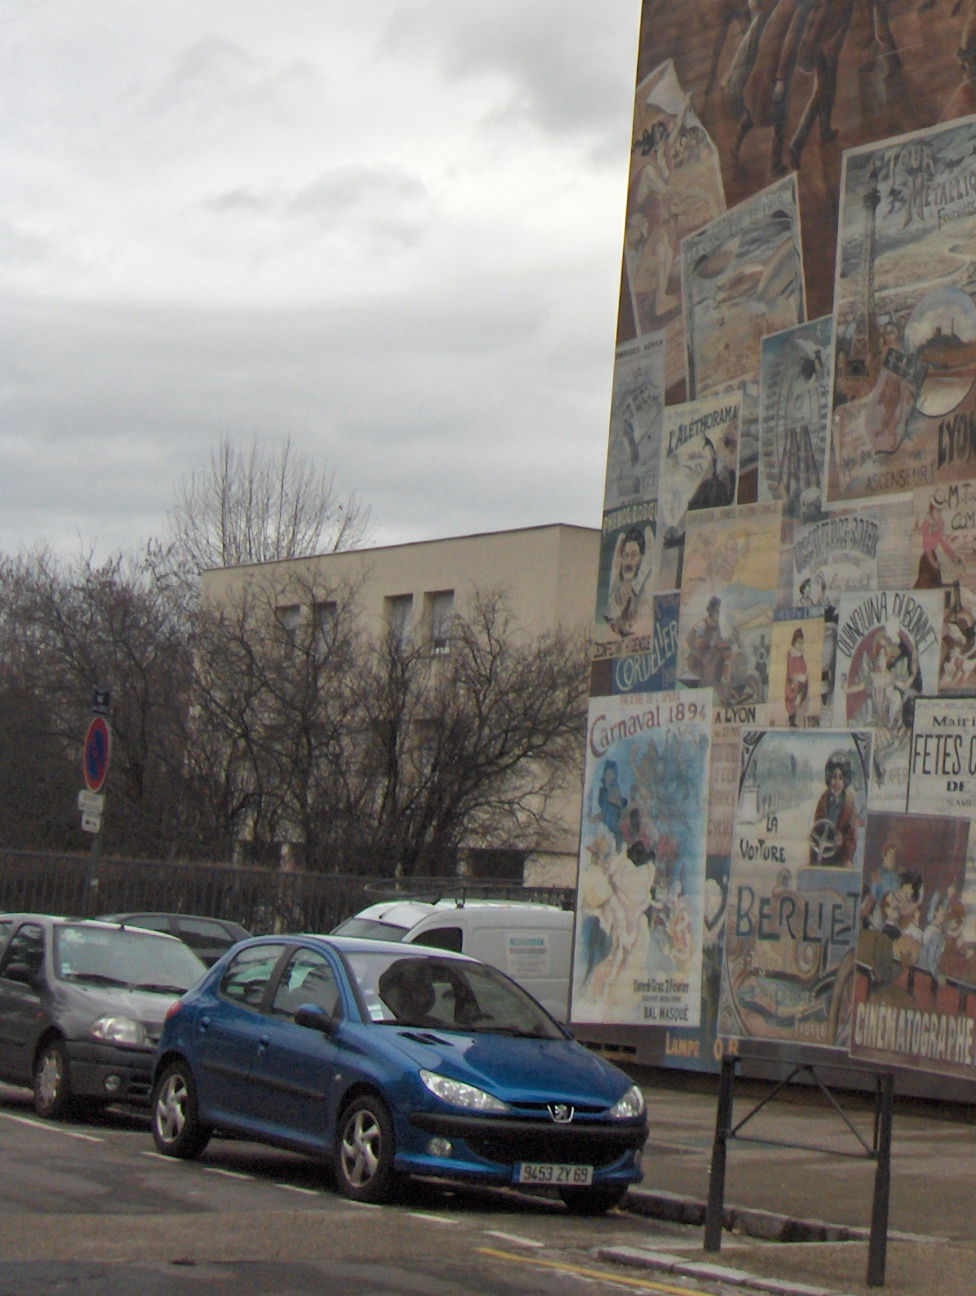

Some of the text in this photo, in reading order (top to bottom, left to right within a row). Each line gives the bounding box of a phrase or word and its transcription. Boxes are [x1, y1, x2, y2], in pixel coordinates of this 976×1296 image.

[837, 592, 888, 658] QUINQUINA
[715, 707, 756, 723] A LYON
[589, 702, 706, 758] Carnaval 1894
[912, 734, 963, 775] FETES
[946, 781, 970, 792] DE
[766, 815, 778, 833] LA
[739, 838, 786, 864] VOITURE
[735, 885, 861, 946] BERLIET
[644, 1006, 656, 1019] BAL
[523, 1166, 589, 1182] 9453 ZY 69
